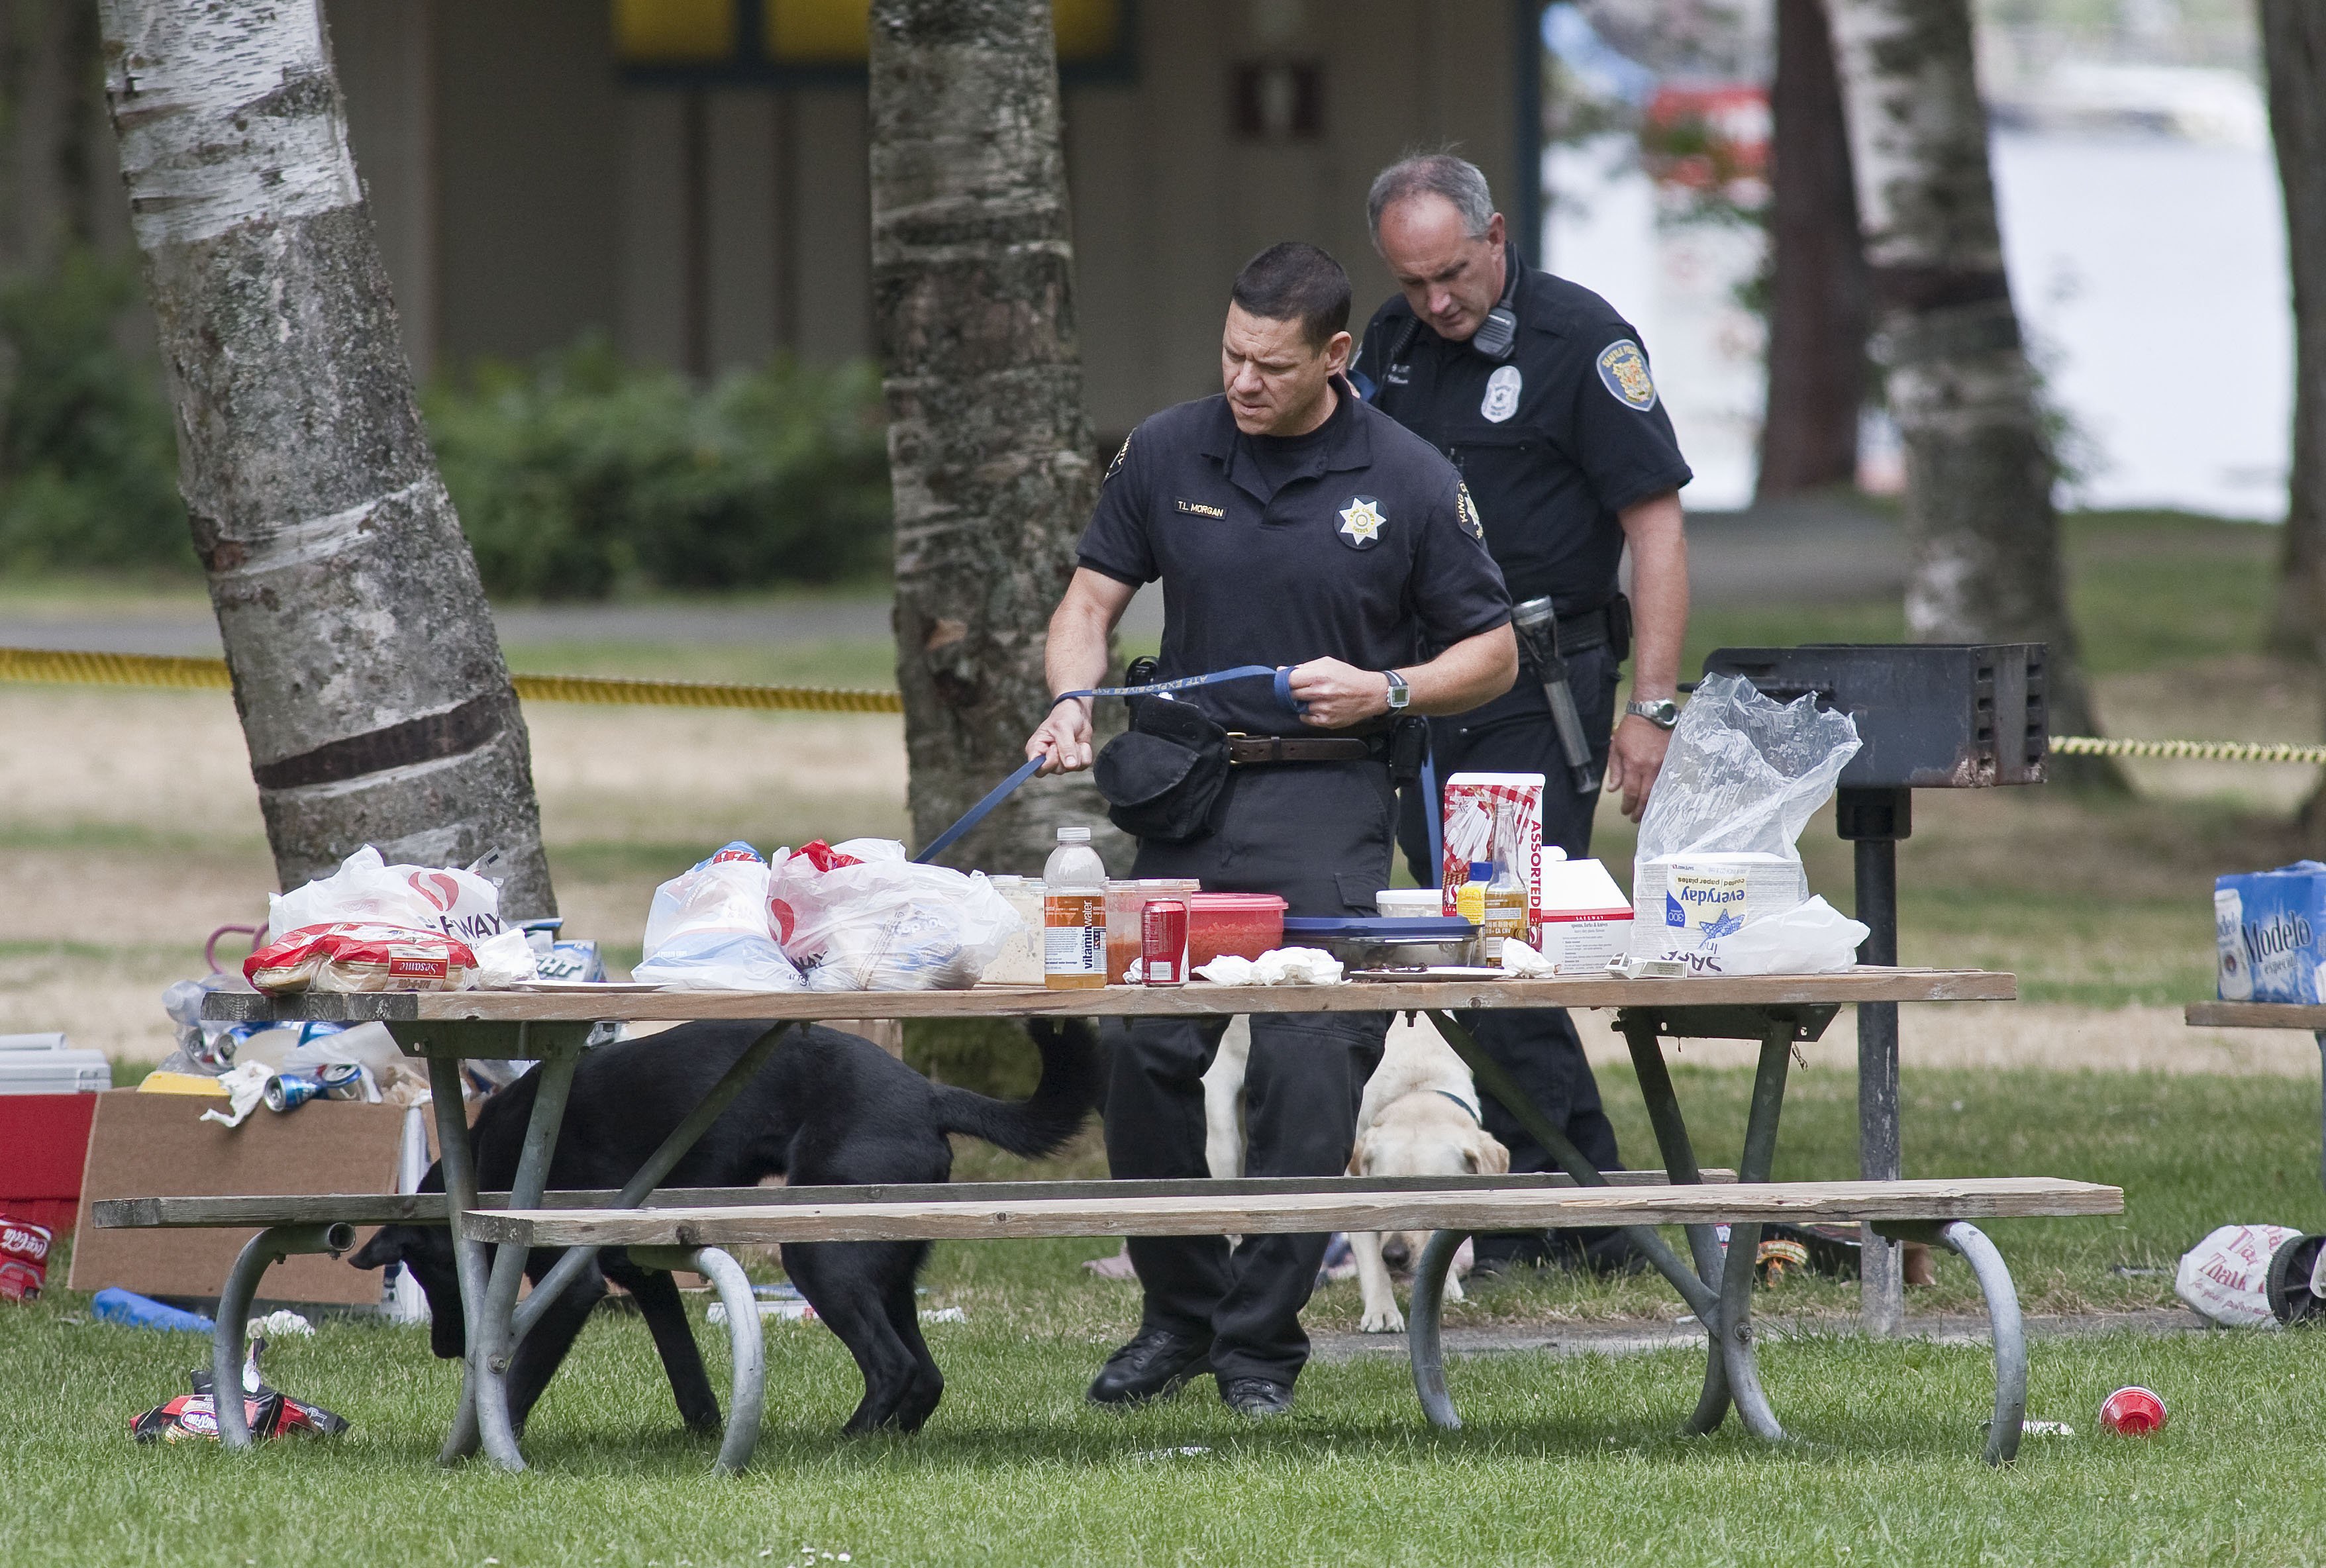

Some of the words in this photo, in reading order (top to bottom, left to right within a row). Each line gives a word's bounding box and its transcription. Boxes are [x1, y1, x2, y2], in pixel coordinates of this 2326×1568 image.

[1190, 503, 1224, 517] MORGAN
[1114, 679, 1183, 694] EXPLOSIVES
[1186, 675, 1209, 687] ATF
[1531, 820, 1541, 907] ASSORTED
[1681, 886, 1745, 906] everyday
[1669, 912, 1684, 922] 300
[2242, 911, 2312, 963] Modelo
[399, 961, 439, 975] Sesame
